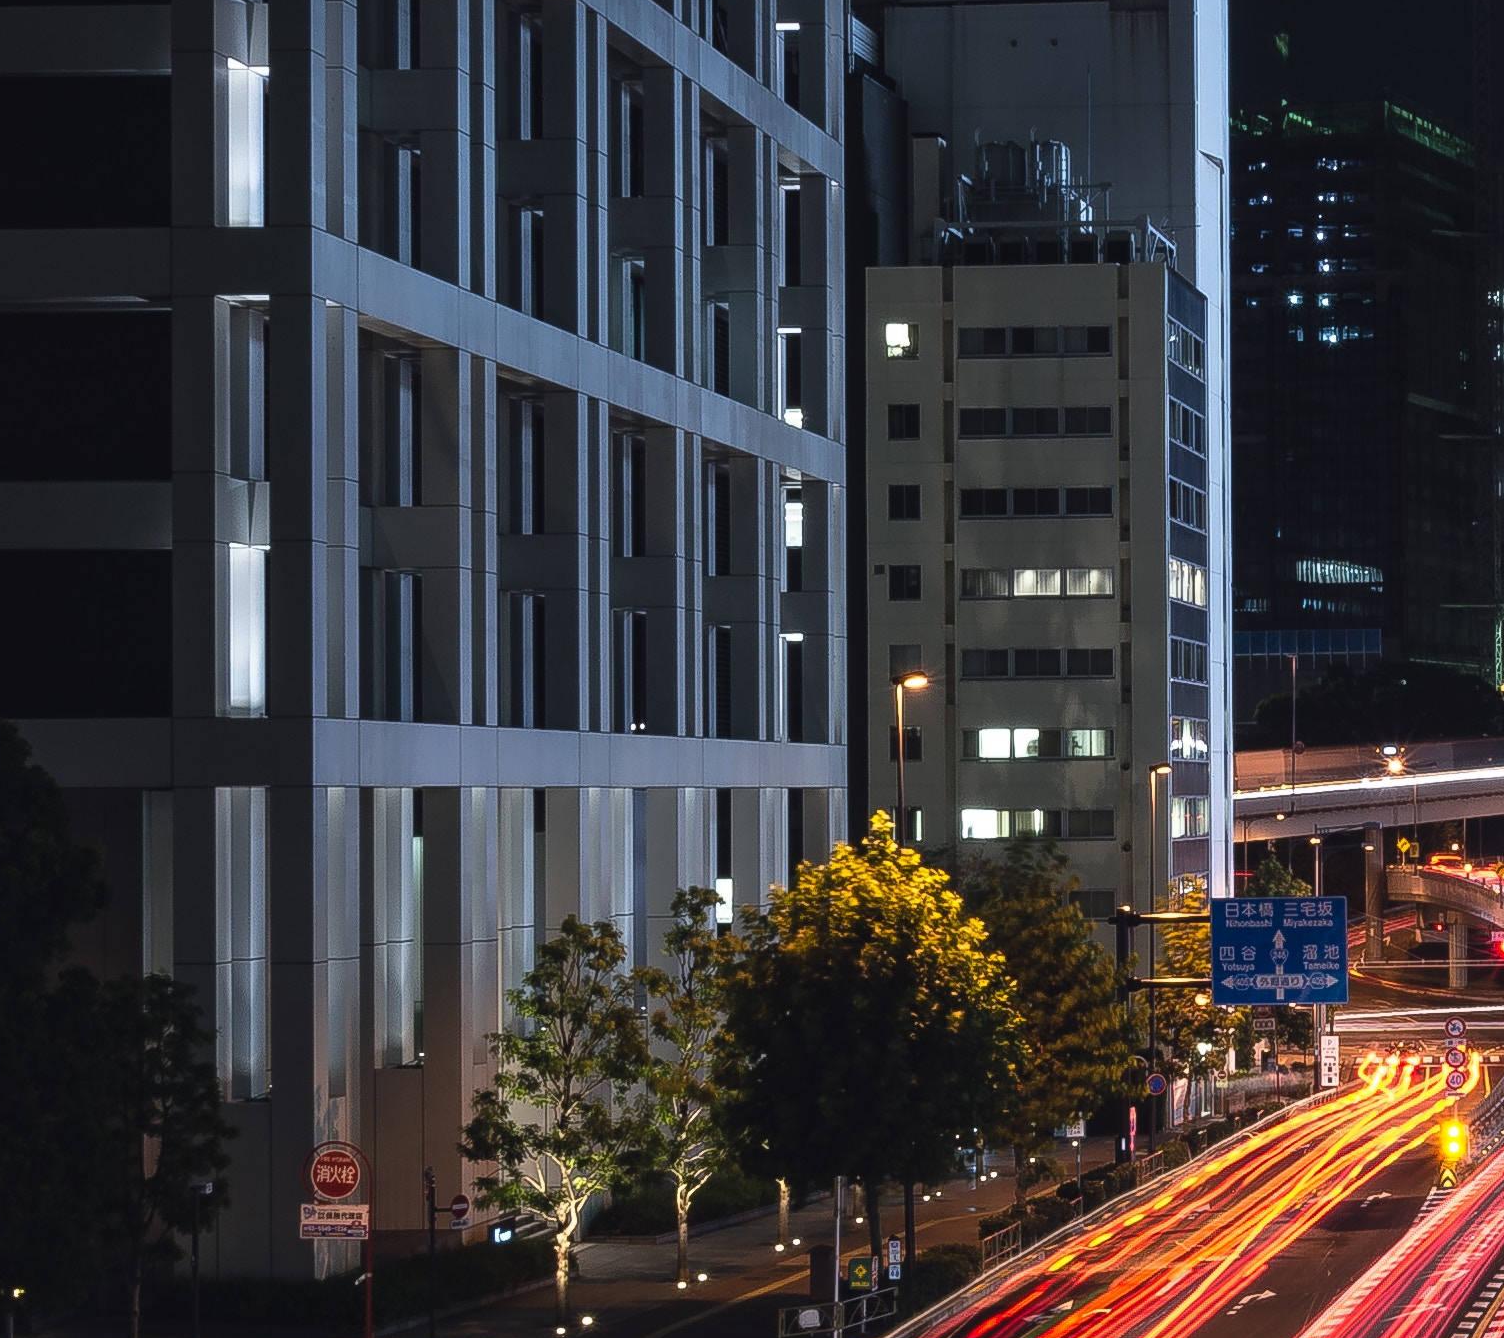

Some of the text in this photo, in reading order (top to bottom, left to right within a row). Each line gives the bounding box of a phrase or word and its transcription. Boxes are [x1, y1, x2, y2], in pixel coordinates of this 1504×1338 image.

[1225, 901, 1333, 918] 日本橋 三宅坂
[1225, 919, 1334, 928] Nihonbashi Miyakezaka
[1219, 944, 1340, 961] 四谷 溜池
[1450, 1075, 1462, 1085] 40
[317, 1164, 356, 1184] 消火栓
